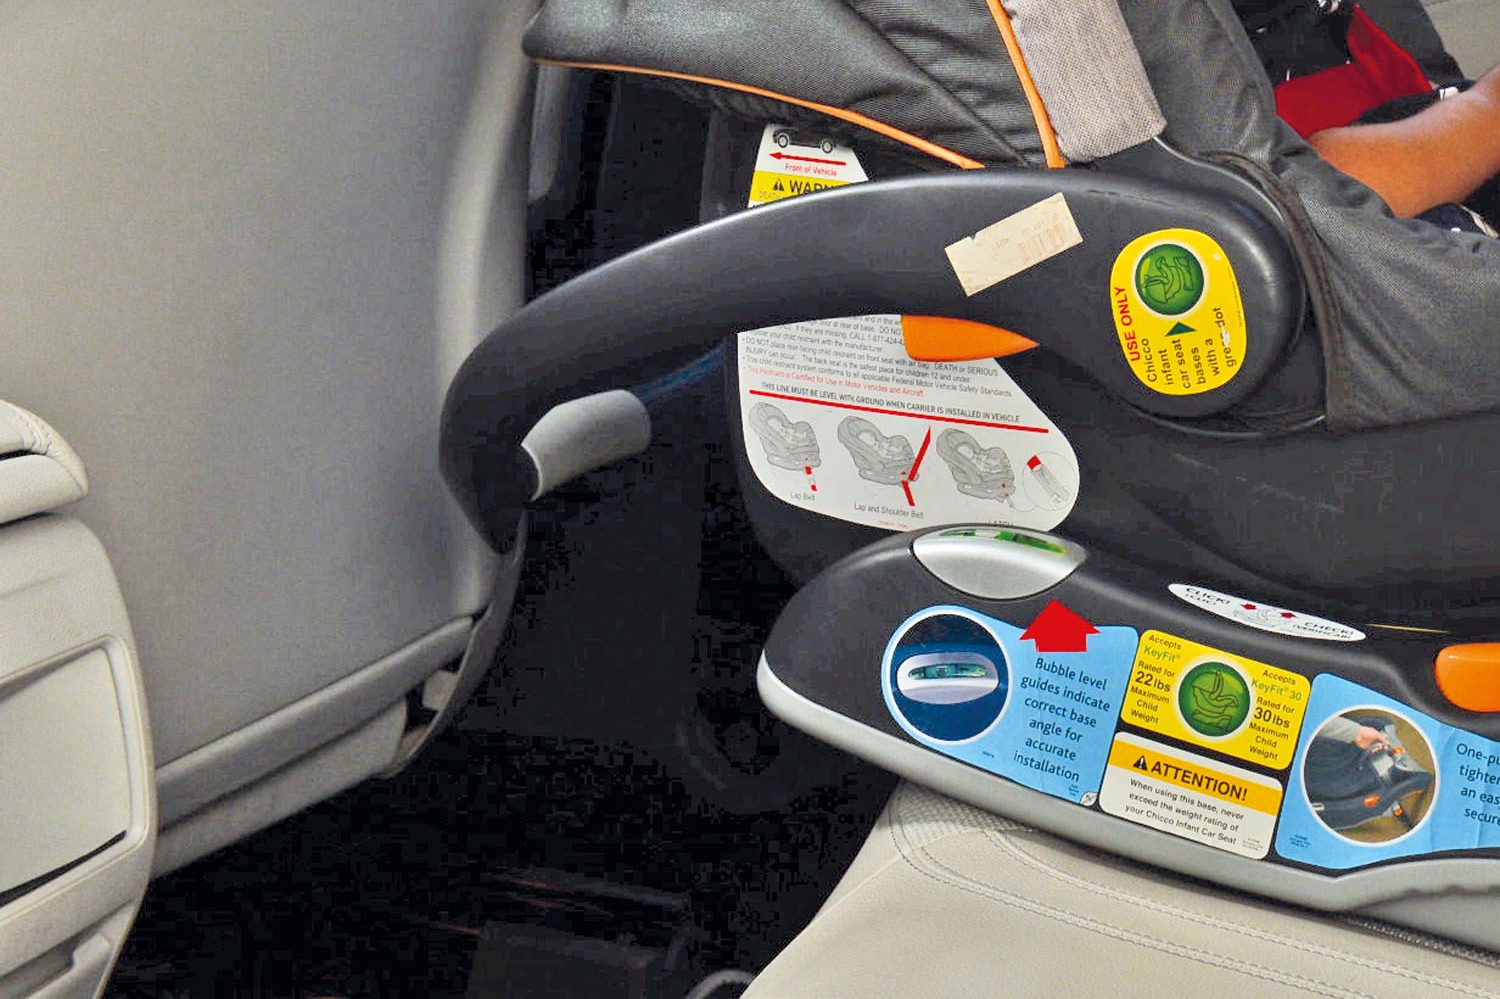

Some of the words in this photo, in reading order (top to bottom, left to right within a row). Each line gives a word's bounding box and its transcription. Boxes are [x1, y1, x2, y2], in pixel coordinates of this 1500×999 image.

[785, 163, 803, 173] Front
[805, 165, 811, 173] of
[812, 166, 838, 177] Vehicle
[1114, 286, 1133, 327] ONLY
[1125, 330, 1141, 362] USE
[1171, 338, 1186, 366] seat
[1206, 338, 1214, 347] a
[934, 362, 958, 373] DEATH
[967, 366, 999, 377] SERIOUS
[1142, 338, 1158, 383] Chicco
[1158, 348, 1175, 386] infant
[1191, 347, 1206, 385] bases
[1206, 350, 1220, 377] with
[896, 367, 905, 375] for
[905, 368, 930, 378] children
[940, 373, 951, 381] and
[1177, 368, 1191, 389] car
[892, 376, 915, 386] Federal
[916, 378, 934, 388] Motor
[935, 381, 958, 392] Vehicle
[959, 385, 979, 395] Safety
[762, 382, 775, 391] THIS
[776, 385, 791, 393] LINE
[791, 386, 809, 396] MUST
[810, 389, 819, 397] BE
[820, 390, 839, 401] LEVEL
[840, 393, 856, 402] WITH
[856, 395, 885, 407] GROUND
[886, 400, 907, 410] WHEN
[907, 403, 936, 414] CARRIER
[937, 406, 944, 414] IS
[945, 408, 982, 419] INSTALLED
[983, 411, 991, 420] IN
[992, 413, 1021, 423] VEHICLE
[790, 492, 801, 500] Lap
[803, 493, 816, 501] Belt
[854, 503, 867, 512] Lap
[867, 505, 880, 513] and
[881, 506, 910, 517] Shoulder
[911, 510, 924, 519] Belt
[1149, 635, 1182, 651] Accepts
[1035, 657, 1076, 680] Bubble
[1079, 671, 1108, 691] level
[1138, 661, 1162, 673] Rated
[1164, 666, 1176, 678] for
[1262, 669, 1297, 686] Accepts
[1020, 676, 1060, 695] guides
[1063, 686, 1111, 712] indicate
[1131, 685, 1170, 704] Maximum
[1290, 690, 1303, 702] 30
[1024, 697, 1067, 718] correct
[1070, 708, 1097, 728] base
[1137, 699, 1159, 712] Child
[1257, 697, 1281, 711] Rated
[1283, 703, 1296, 715] for
[1131, 709, 1160, 725] Weight
[1030, 718, 1063, 736] angle
[1066, 728, 1084, 743] for
[1249, 722, 1290, 740] Maximum
[1025, 737, 1077, 761] accurate
[1256, 735, 1278, 748] Child
[1250, 746, 1279, 761] Weight
[1014, 750, 1080, 782] installation
[1151, 761, 1248, 802] ATTENTION!
[1130, 778, 1153, 793] When
[1155, 787, 1178, 802] using
[1180, 793, 1195, 806] this
[1197, 798, 1219, 815] base,
[1221, 809, 1245, 821] never
[1461, 787, 1477, 799] an
[1129, 794, 1159, 808] exceed
[1160, 801, 1174, 812] the
[1175, 806, 1203, 822] weight
[1204, 815, 1228, 831] rating
[1230, 824, 1240, 833] of
[1125, 805, 1145, 815] your
[1146, 810, 1175, 826] Chicco
[1176, 819, 1200, 835] Infant
[1201, 827, 1216, 839] Car
[1217, 832, 1237, 845] Seat
